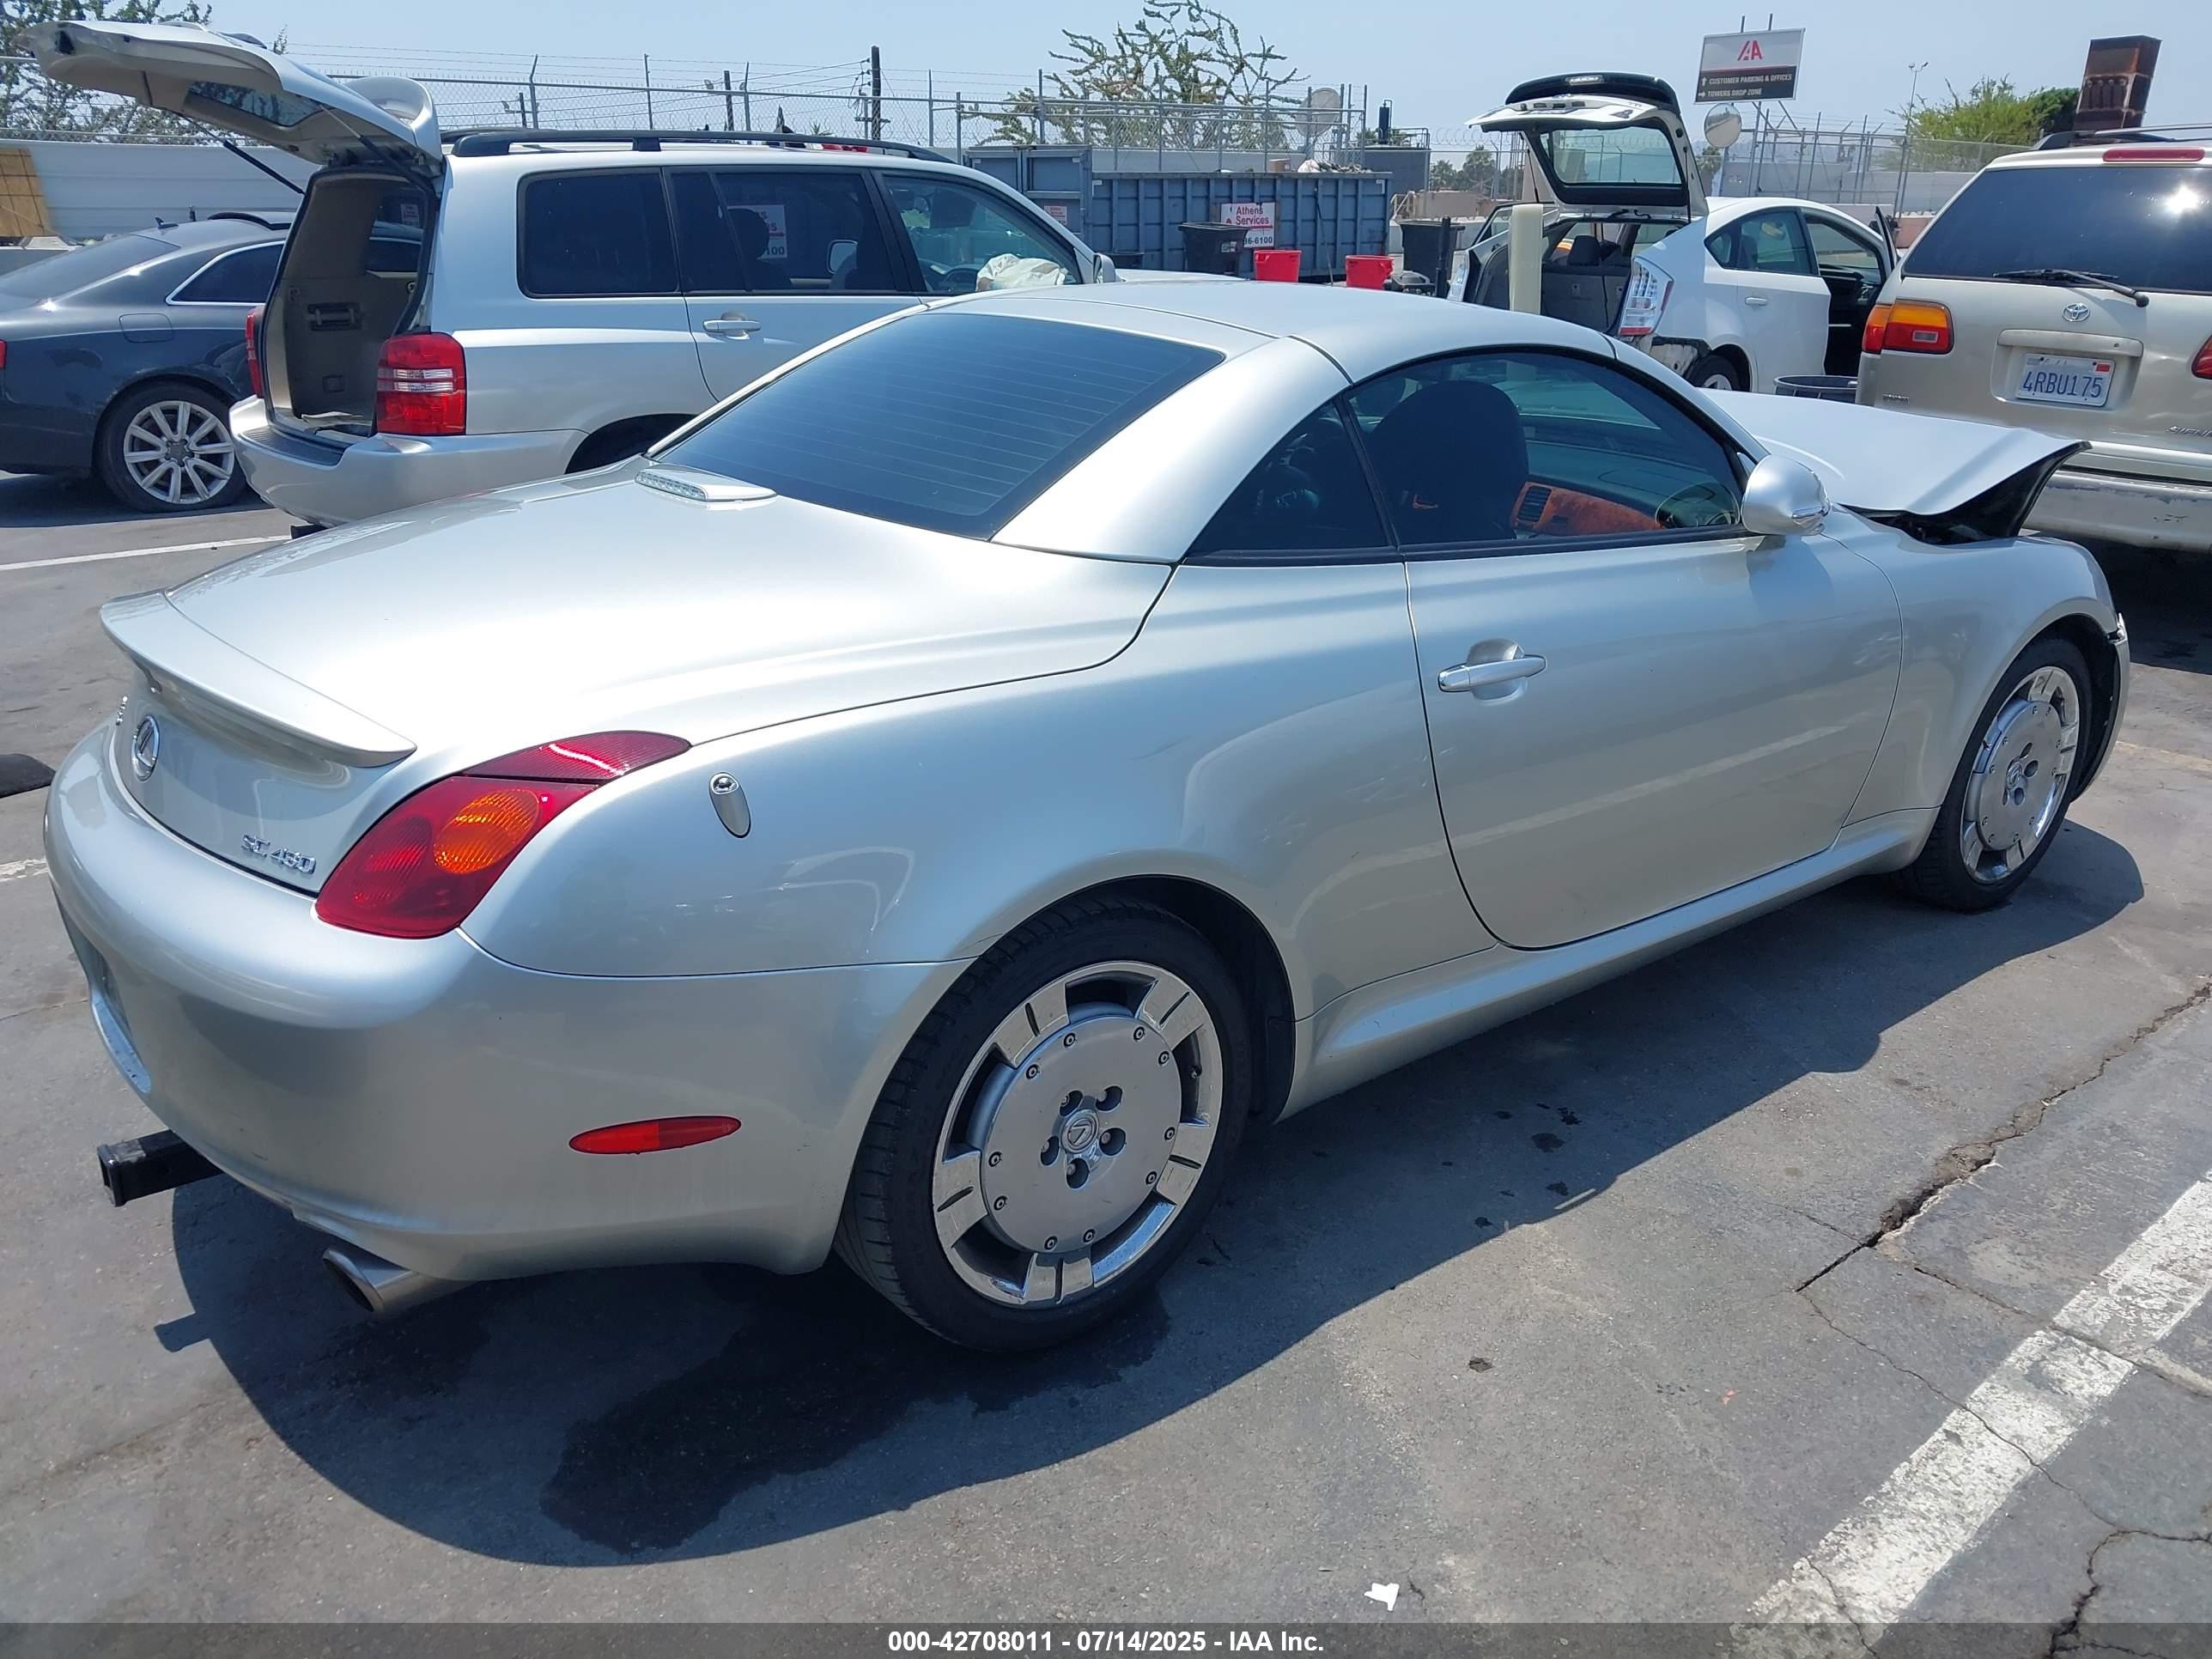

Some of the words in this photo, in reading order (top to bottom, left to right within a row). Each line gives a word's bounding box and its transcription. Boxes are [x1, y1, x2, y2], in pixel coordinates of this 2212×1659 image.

[1236, 206, 1263, 216] Athens
[1236, 216, 1269, 225] Services
[2022, 371, 2103, 398] 4RBU175
[241, 835, 270, 858] SC
